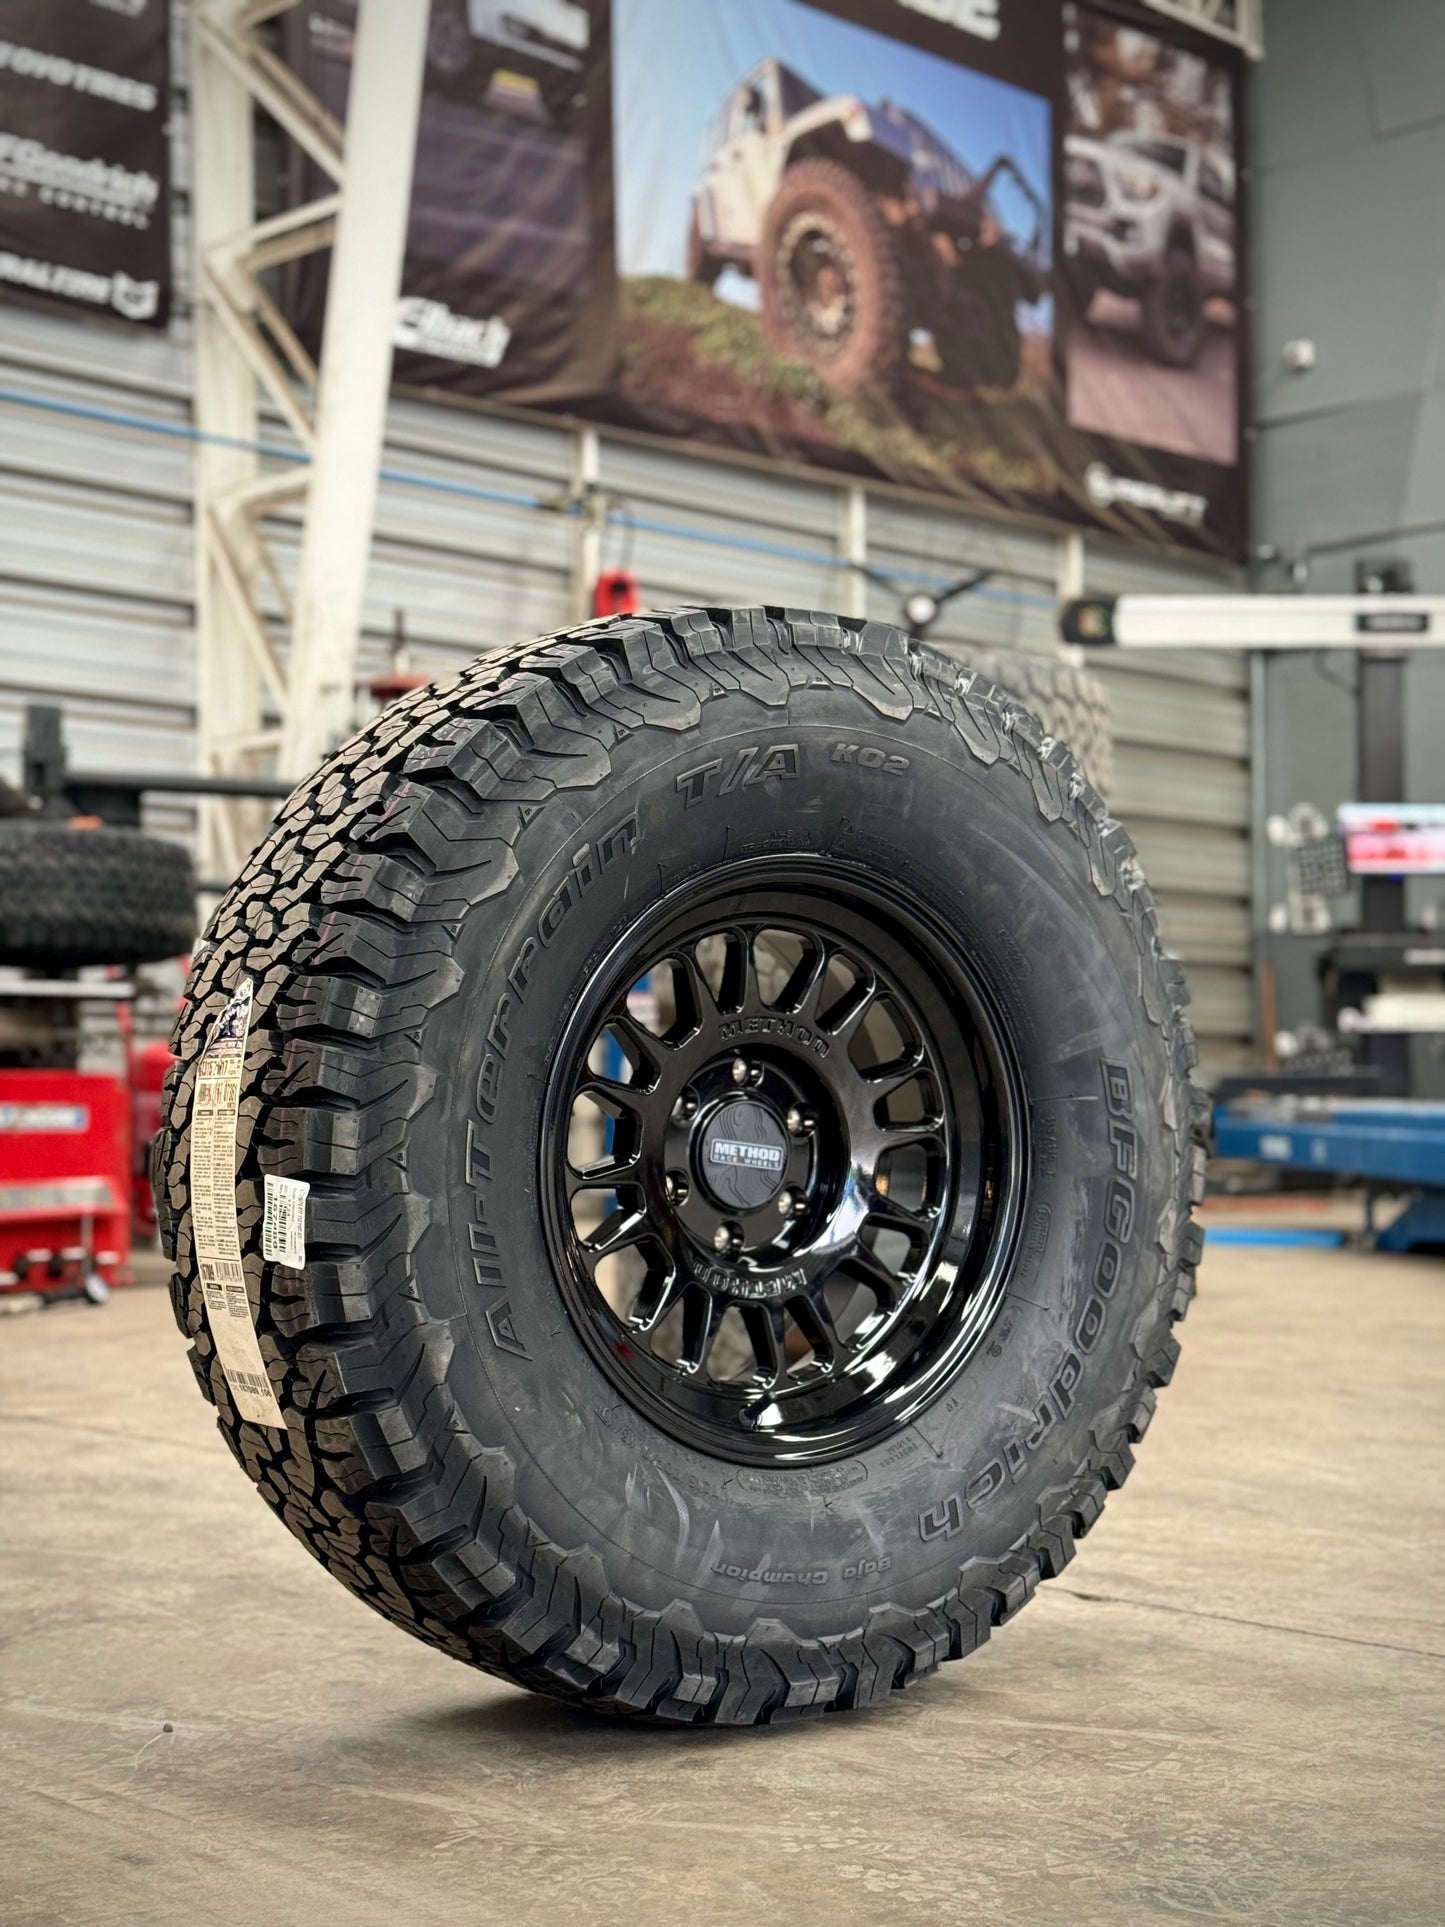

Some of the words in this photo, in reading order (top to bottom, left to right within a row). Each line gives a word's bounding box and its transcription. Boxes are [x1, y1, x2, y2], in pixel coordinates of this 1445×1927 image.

[465, 811, 643, 1361] All-Terrain
[675, 743, 800, 808] T/A
[830, 743, 911, 777] KO2
[718, 1016, 830, 1058] METHOD
[713, 1154, 738, 1163] RACE
[744, 1158, 779, 1168] WHEELS
[714, 1142, 780, 1161] METHOD
[692, 1262, 808, 1299] METHOD
[919, 1059, 1138, 1542] BFGoodrich
[710, 1561, 829, 1586] Champion
[843, 1555, 893, 1581] Baja
